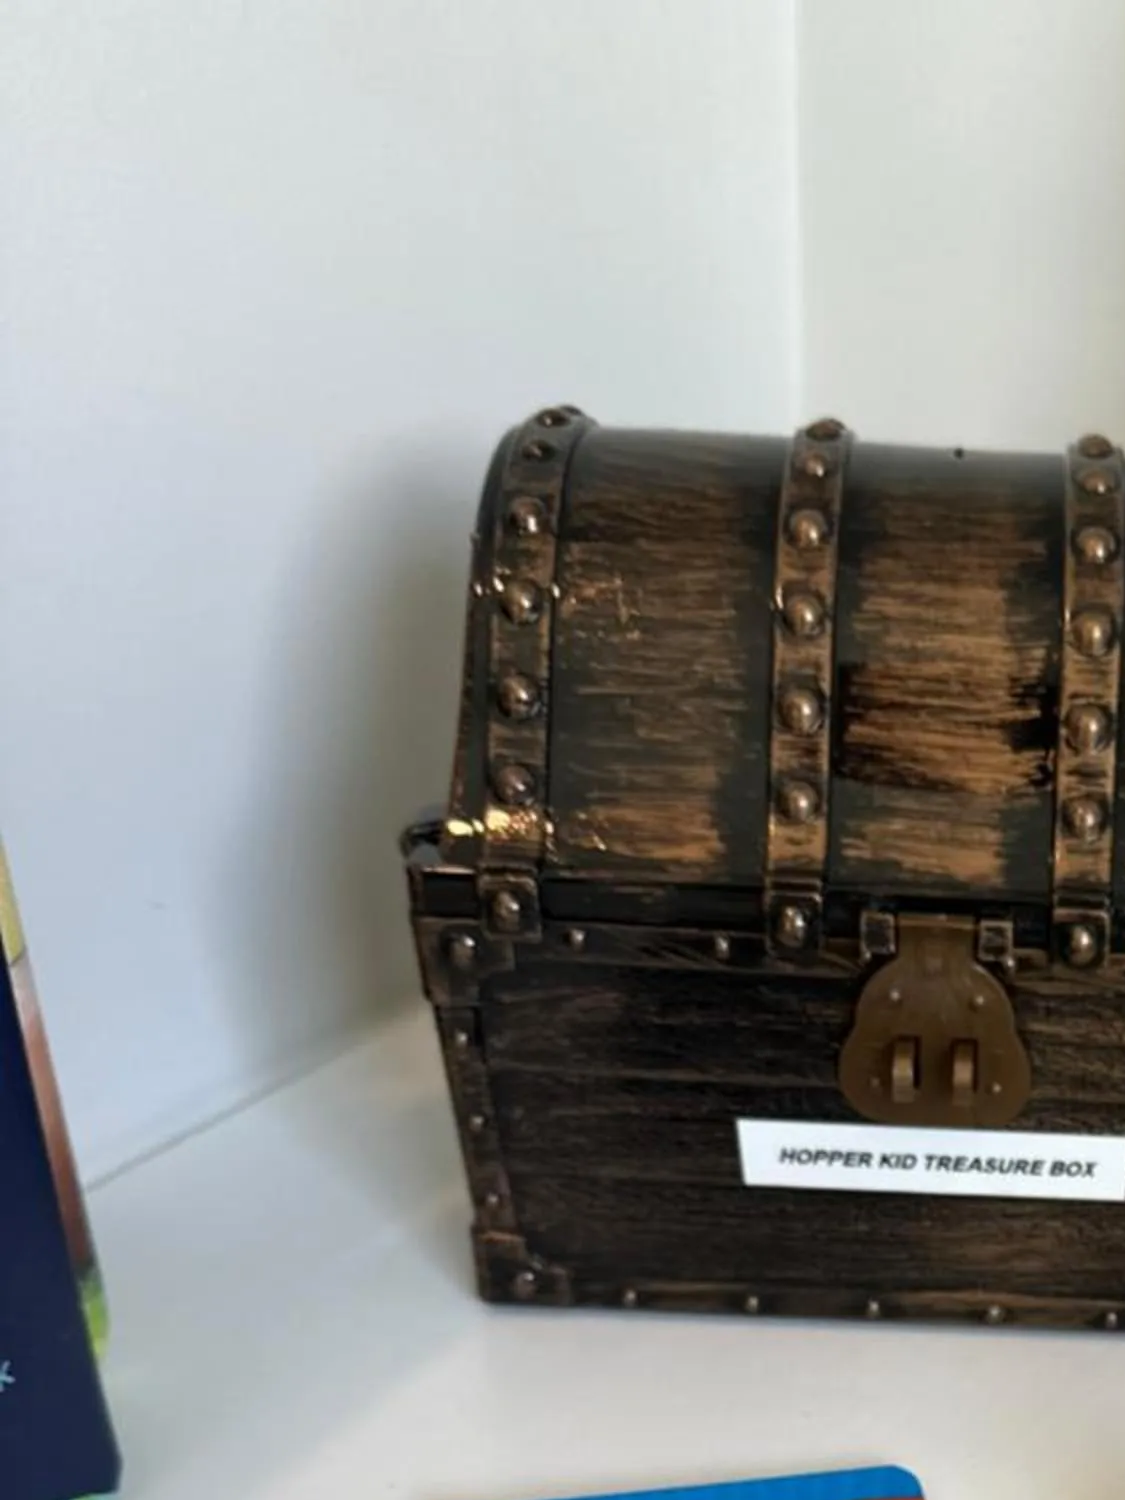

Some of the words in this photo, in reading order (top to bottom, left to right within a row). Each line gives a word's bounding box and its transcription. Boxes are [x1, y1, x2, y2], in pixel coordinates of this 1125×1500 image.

[779, 1147, 873, 1170] HOPPER
[879, 1153, 918, 1171] KID
[923, 1155, 1044, 1177] TREASURE
[1049, 1160, 1098, 1179] BOX
